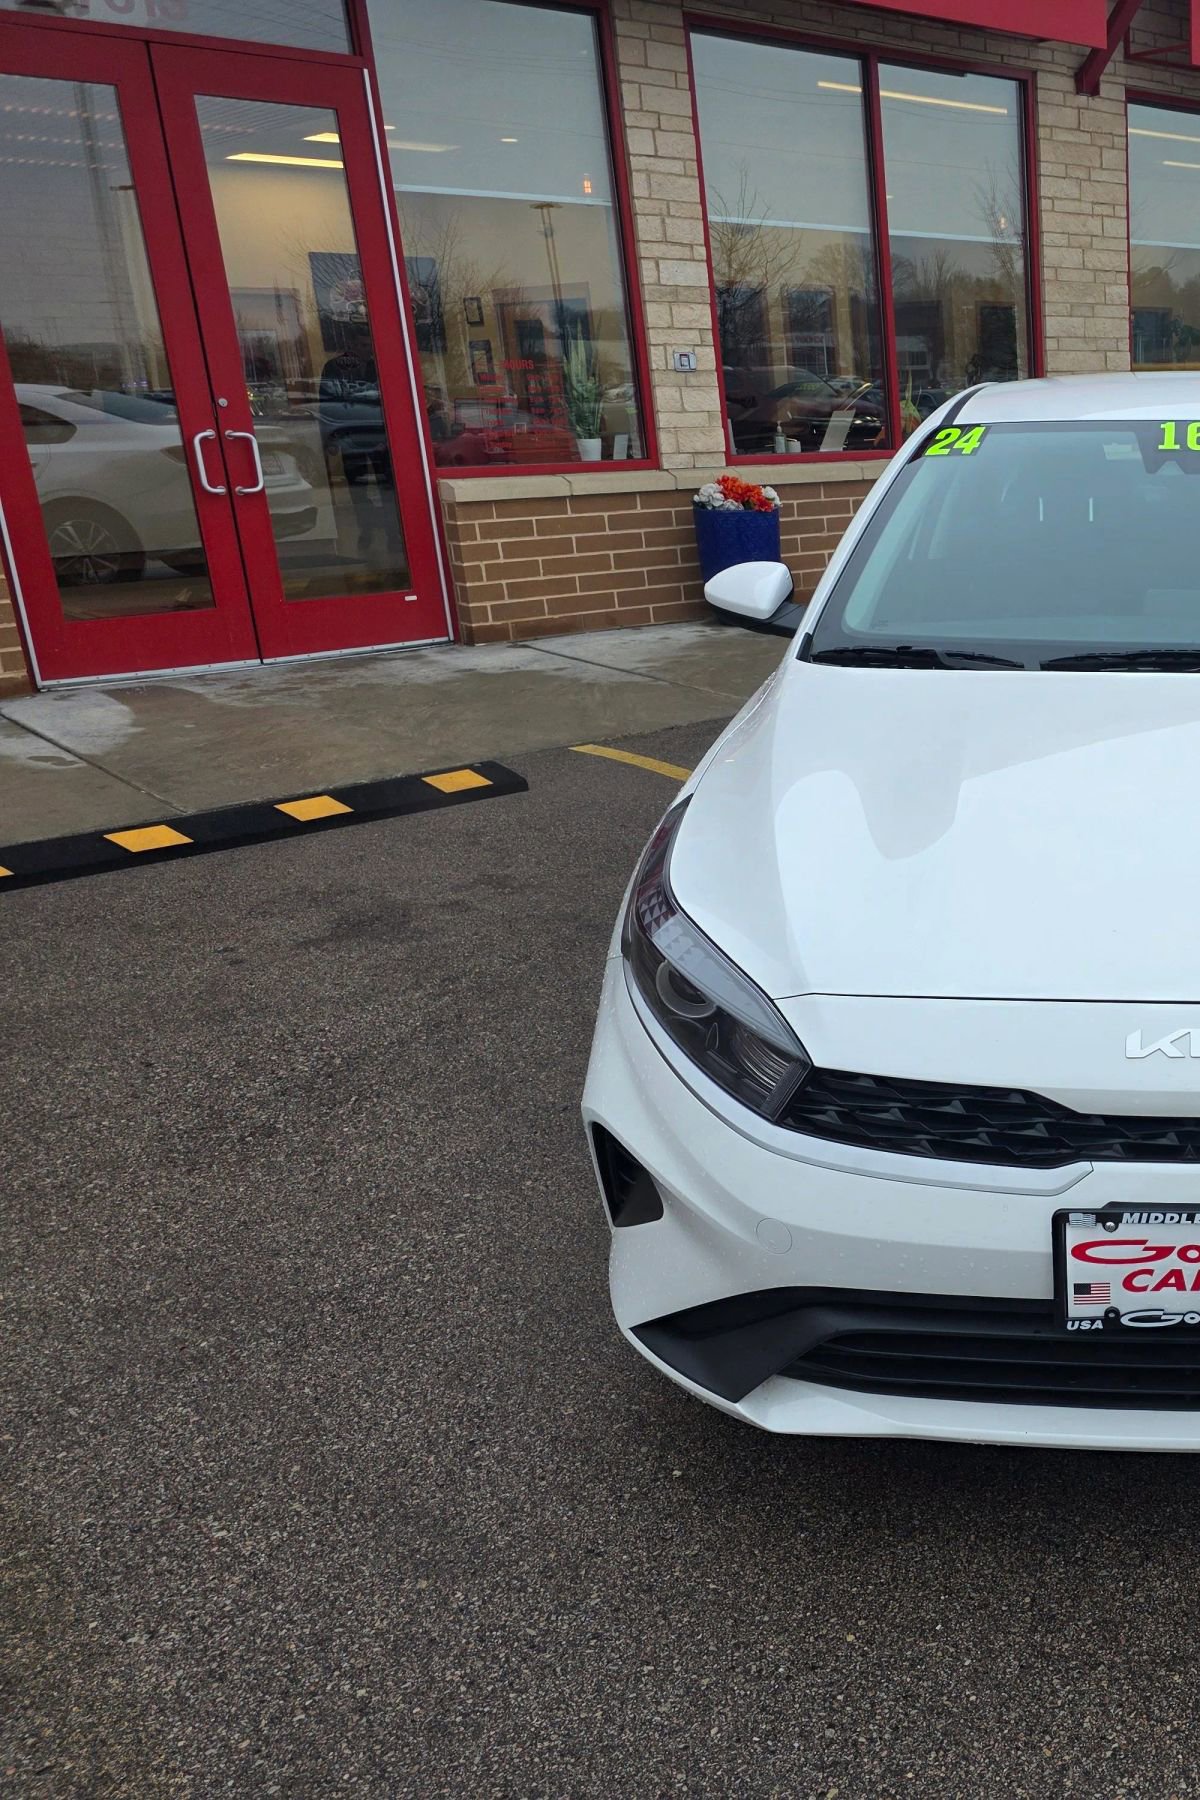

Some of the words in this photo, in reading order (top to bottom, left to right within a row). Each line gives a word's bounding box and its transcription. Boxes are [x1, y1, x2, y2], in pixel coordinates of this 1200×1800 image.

[503, 359, 534, 369] HOURS
[925, 426, 985, 455] 24
[1066, 1319, 1104, 1331] USA
